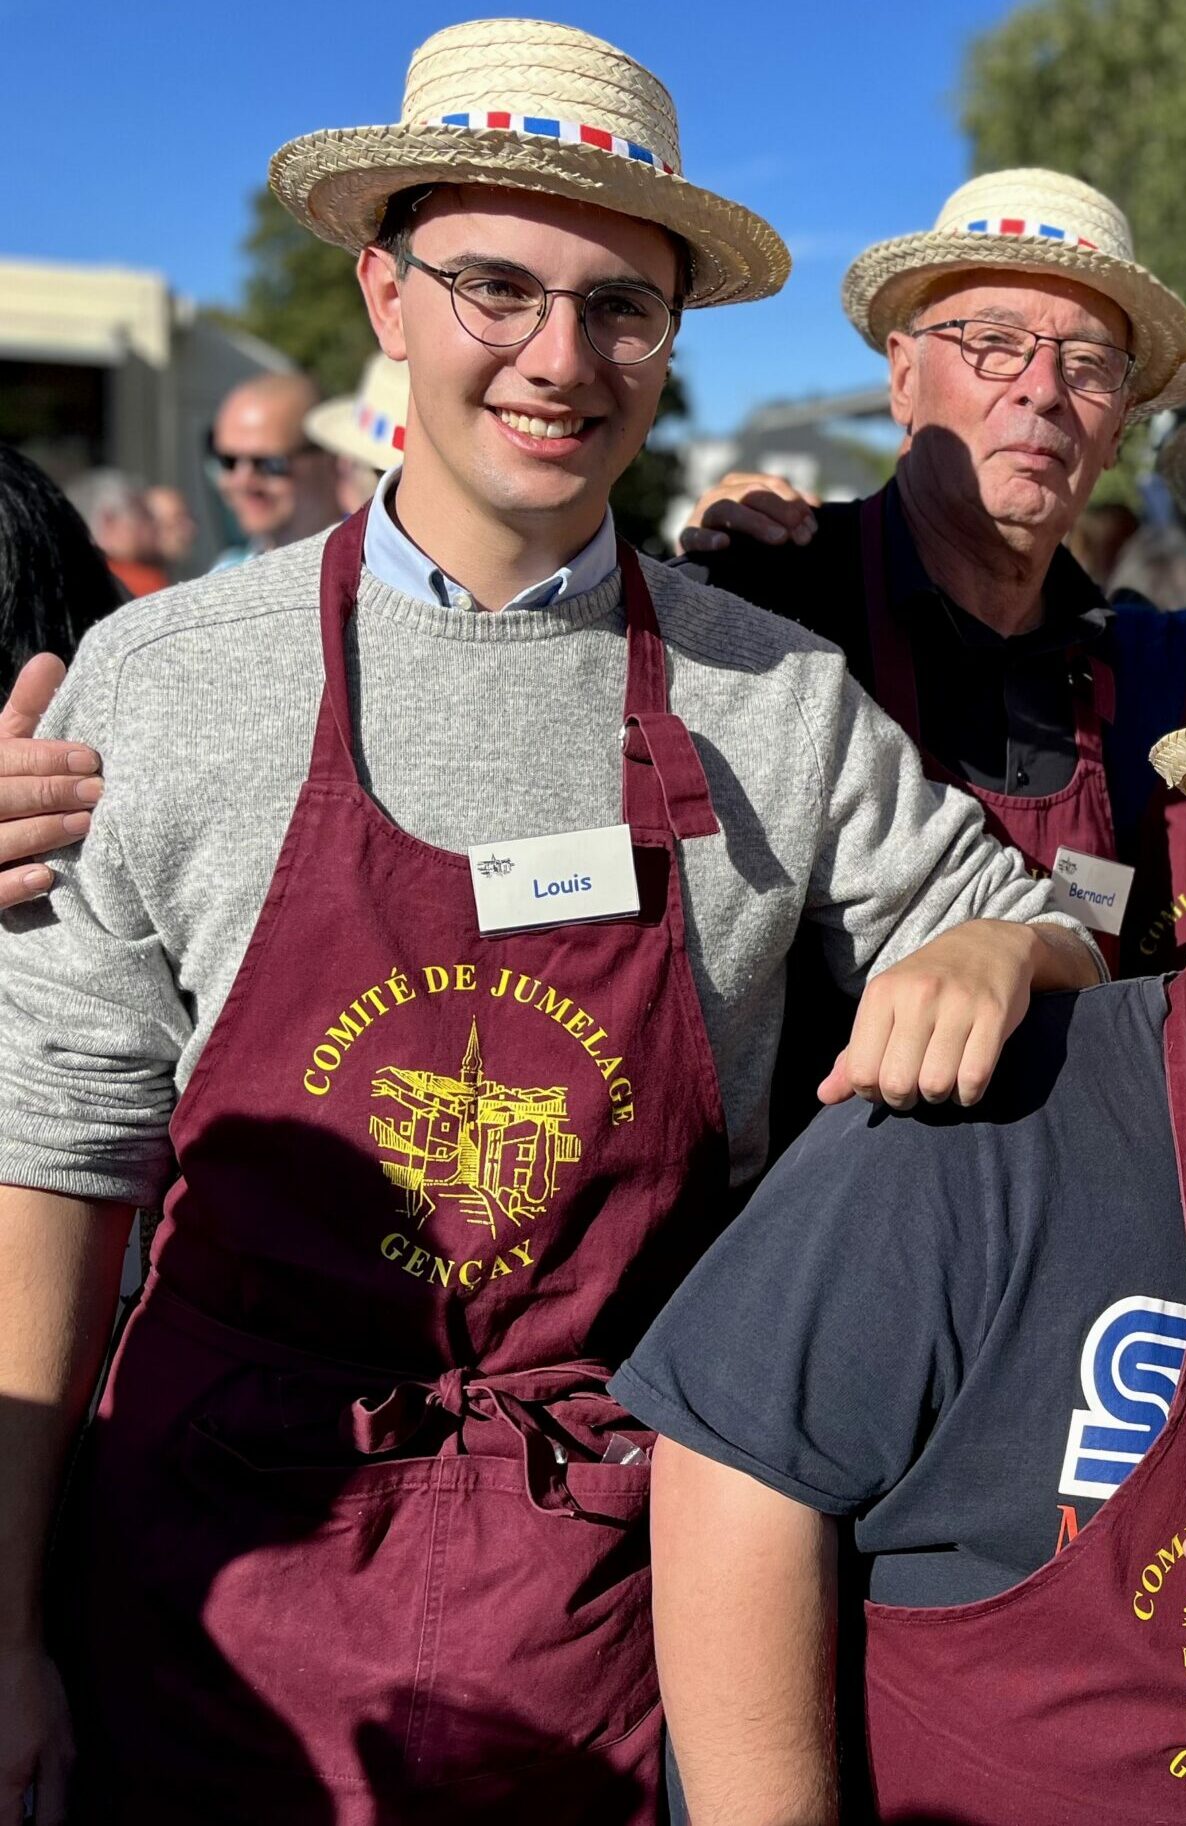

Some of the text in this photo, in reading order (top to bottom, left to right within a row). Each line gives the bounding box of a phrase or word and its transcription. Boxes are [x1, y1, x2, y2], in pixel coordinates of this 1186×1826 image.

[533, 874, 592, 899] Louis
[1069, 883, 1116, 907] Bernard
[304, 964, 635, 1126] COMITÉ DE JUMELAGE
[380, 1232, 535, 1291] GENÇAY
